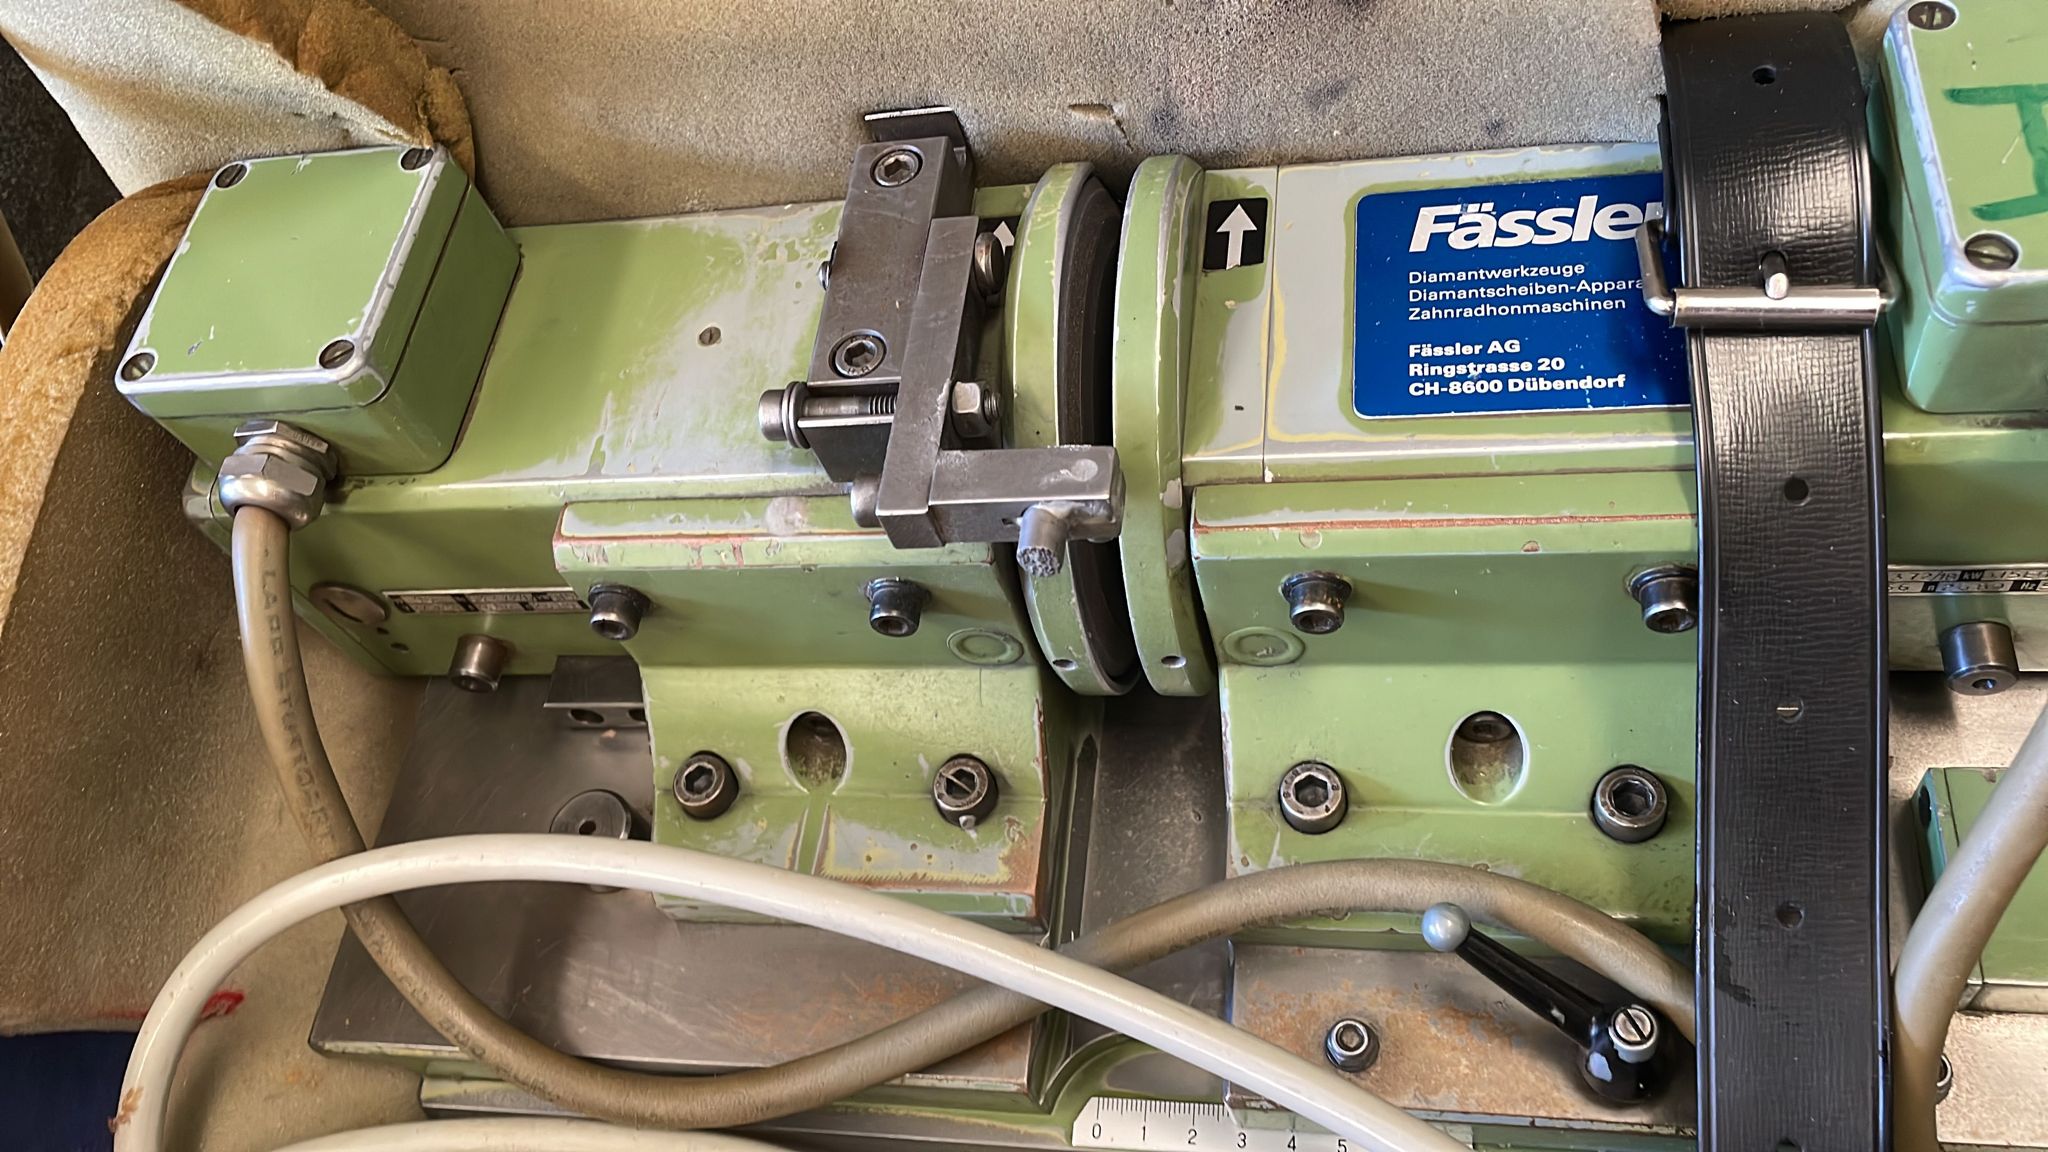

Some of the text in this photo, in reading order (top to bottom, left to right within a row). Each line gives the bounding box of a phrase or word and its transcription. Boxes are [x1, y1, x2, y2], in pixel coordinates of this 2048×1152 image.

[1408, 263, 1586, 285] Diamantwerkzeuge
[1408, 278, 1643, 302] Diamantscheiben-Appara
[1408, 298, 1627, 321] Zahnradhonmaschinen
[1408, 340, 1521, 358] Fässler AG
[1408, 357, 1566, 378] Ringstrasse 20
[1408, 374, 1627, 396] CH-8600 Dübendorf
[1092, 1123, 1347, 1152] 0 1 2 3 4 5
